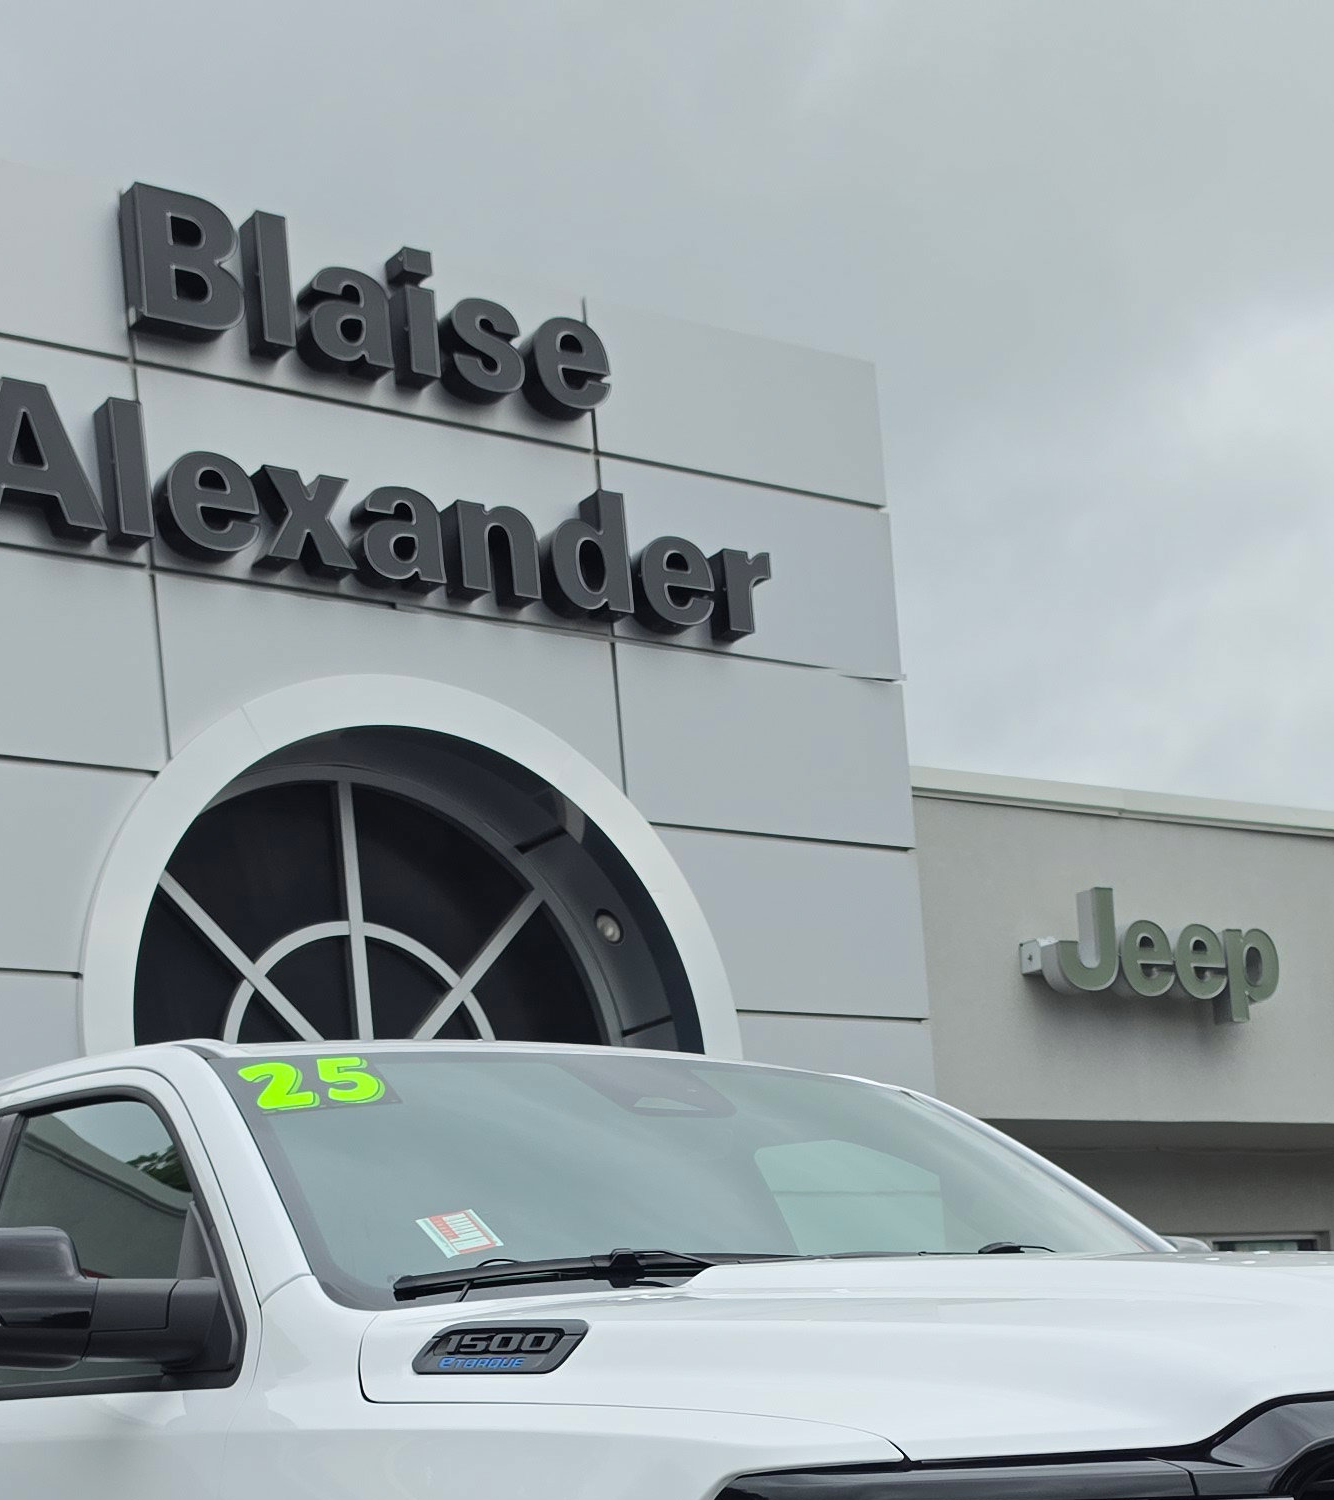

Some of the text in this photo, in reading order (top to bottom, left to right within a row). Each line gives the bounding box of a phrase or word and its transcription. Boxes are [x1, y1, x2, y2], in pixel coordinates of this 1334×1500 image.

[118, 180, 611, 421] Blaise
[1043, 887, 1279, 1023] Jeep
[237, 1056, 385, 1110] 25
[445, 1332, 557, 1354] 1500
